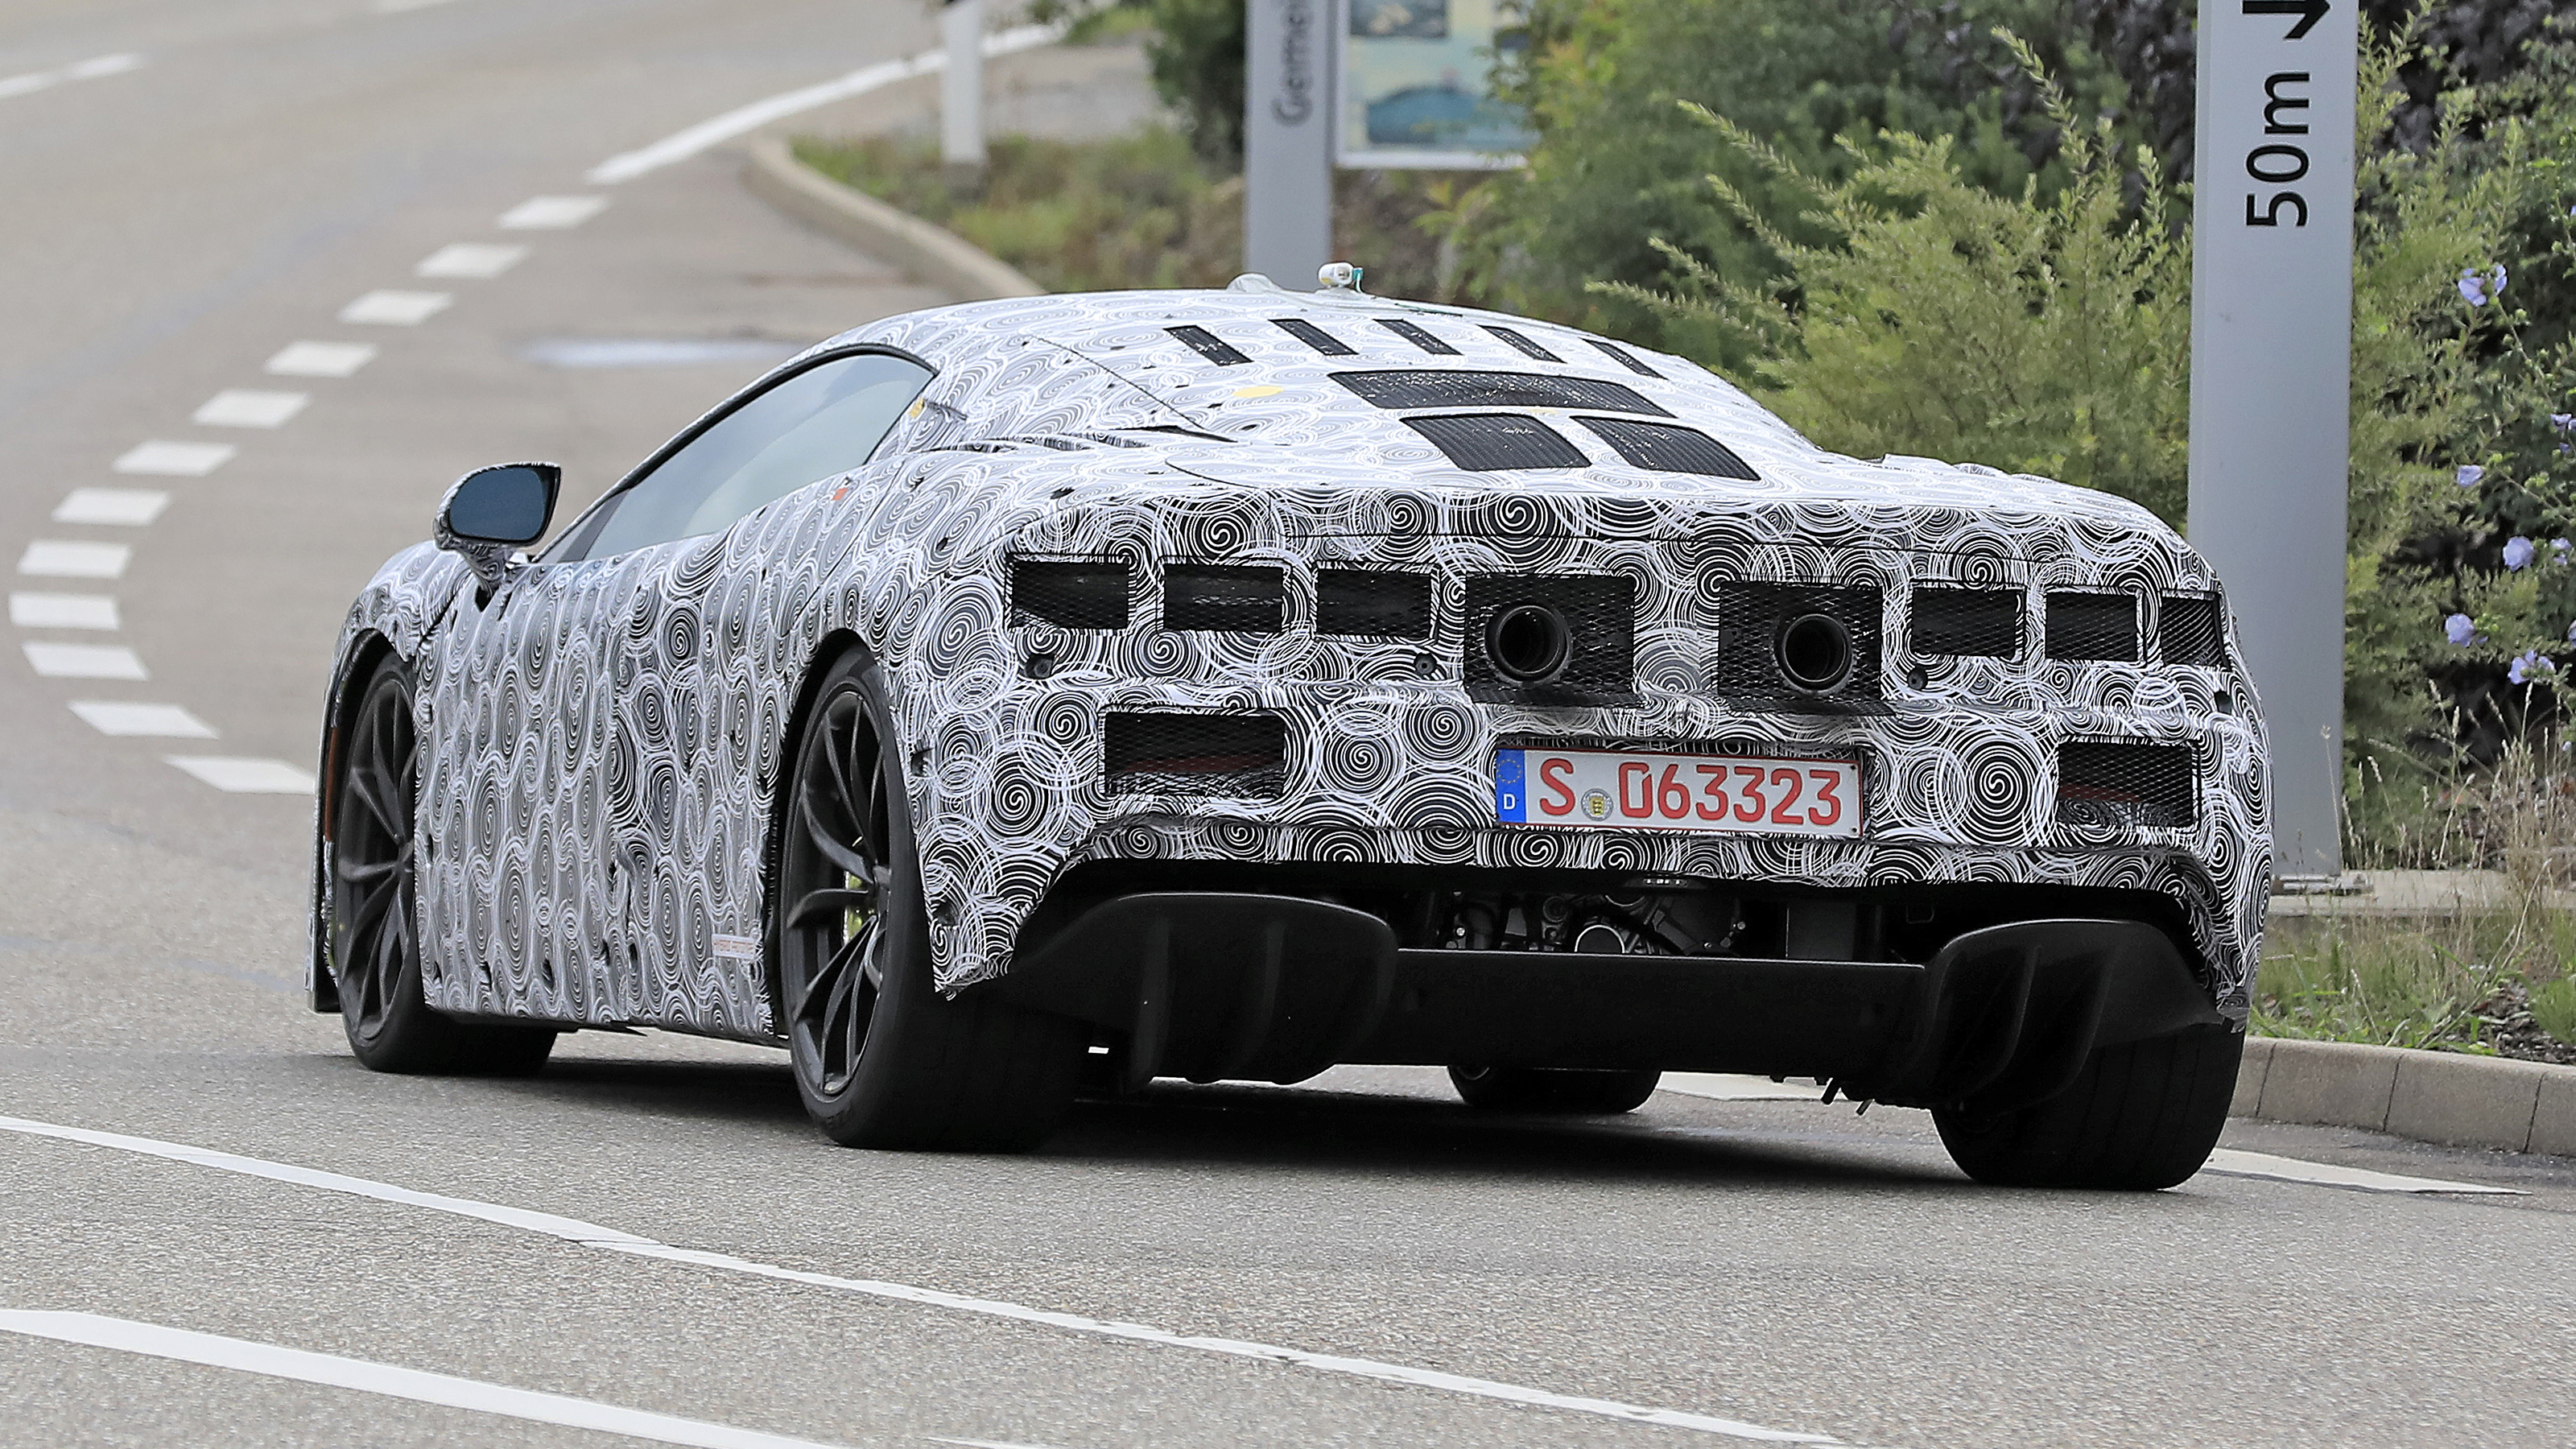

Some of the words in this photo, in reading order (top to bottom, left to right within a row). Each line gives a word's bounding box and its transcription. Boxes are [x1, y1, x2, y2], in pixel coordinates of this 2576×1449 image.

[2246, 71, 2310, 226] 50m
[1503, 793, 1516, 810] D
[1539, 758, 1575, 816] S
[1618, 762, 1842, 826] 063323
